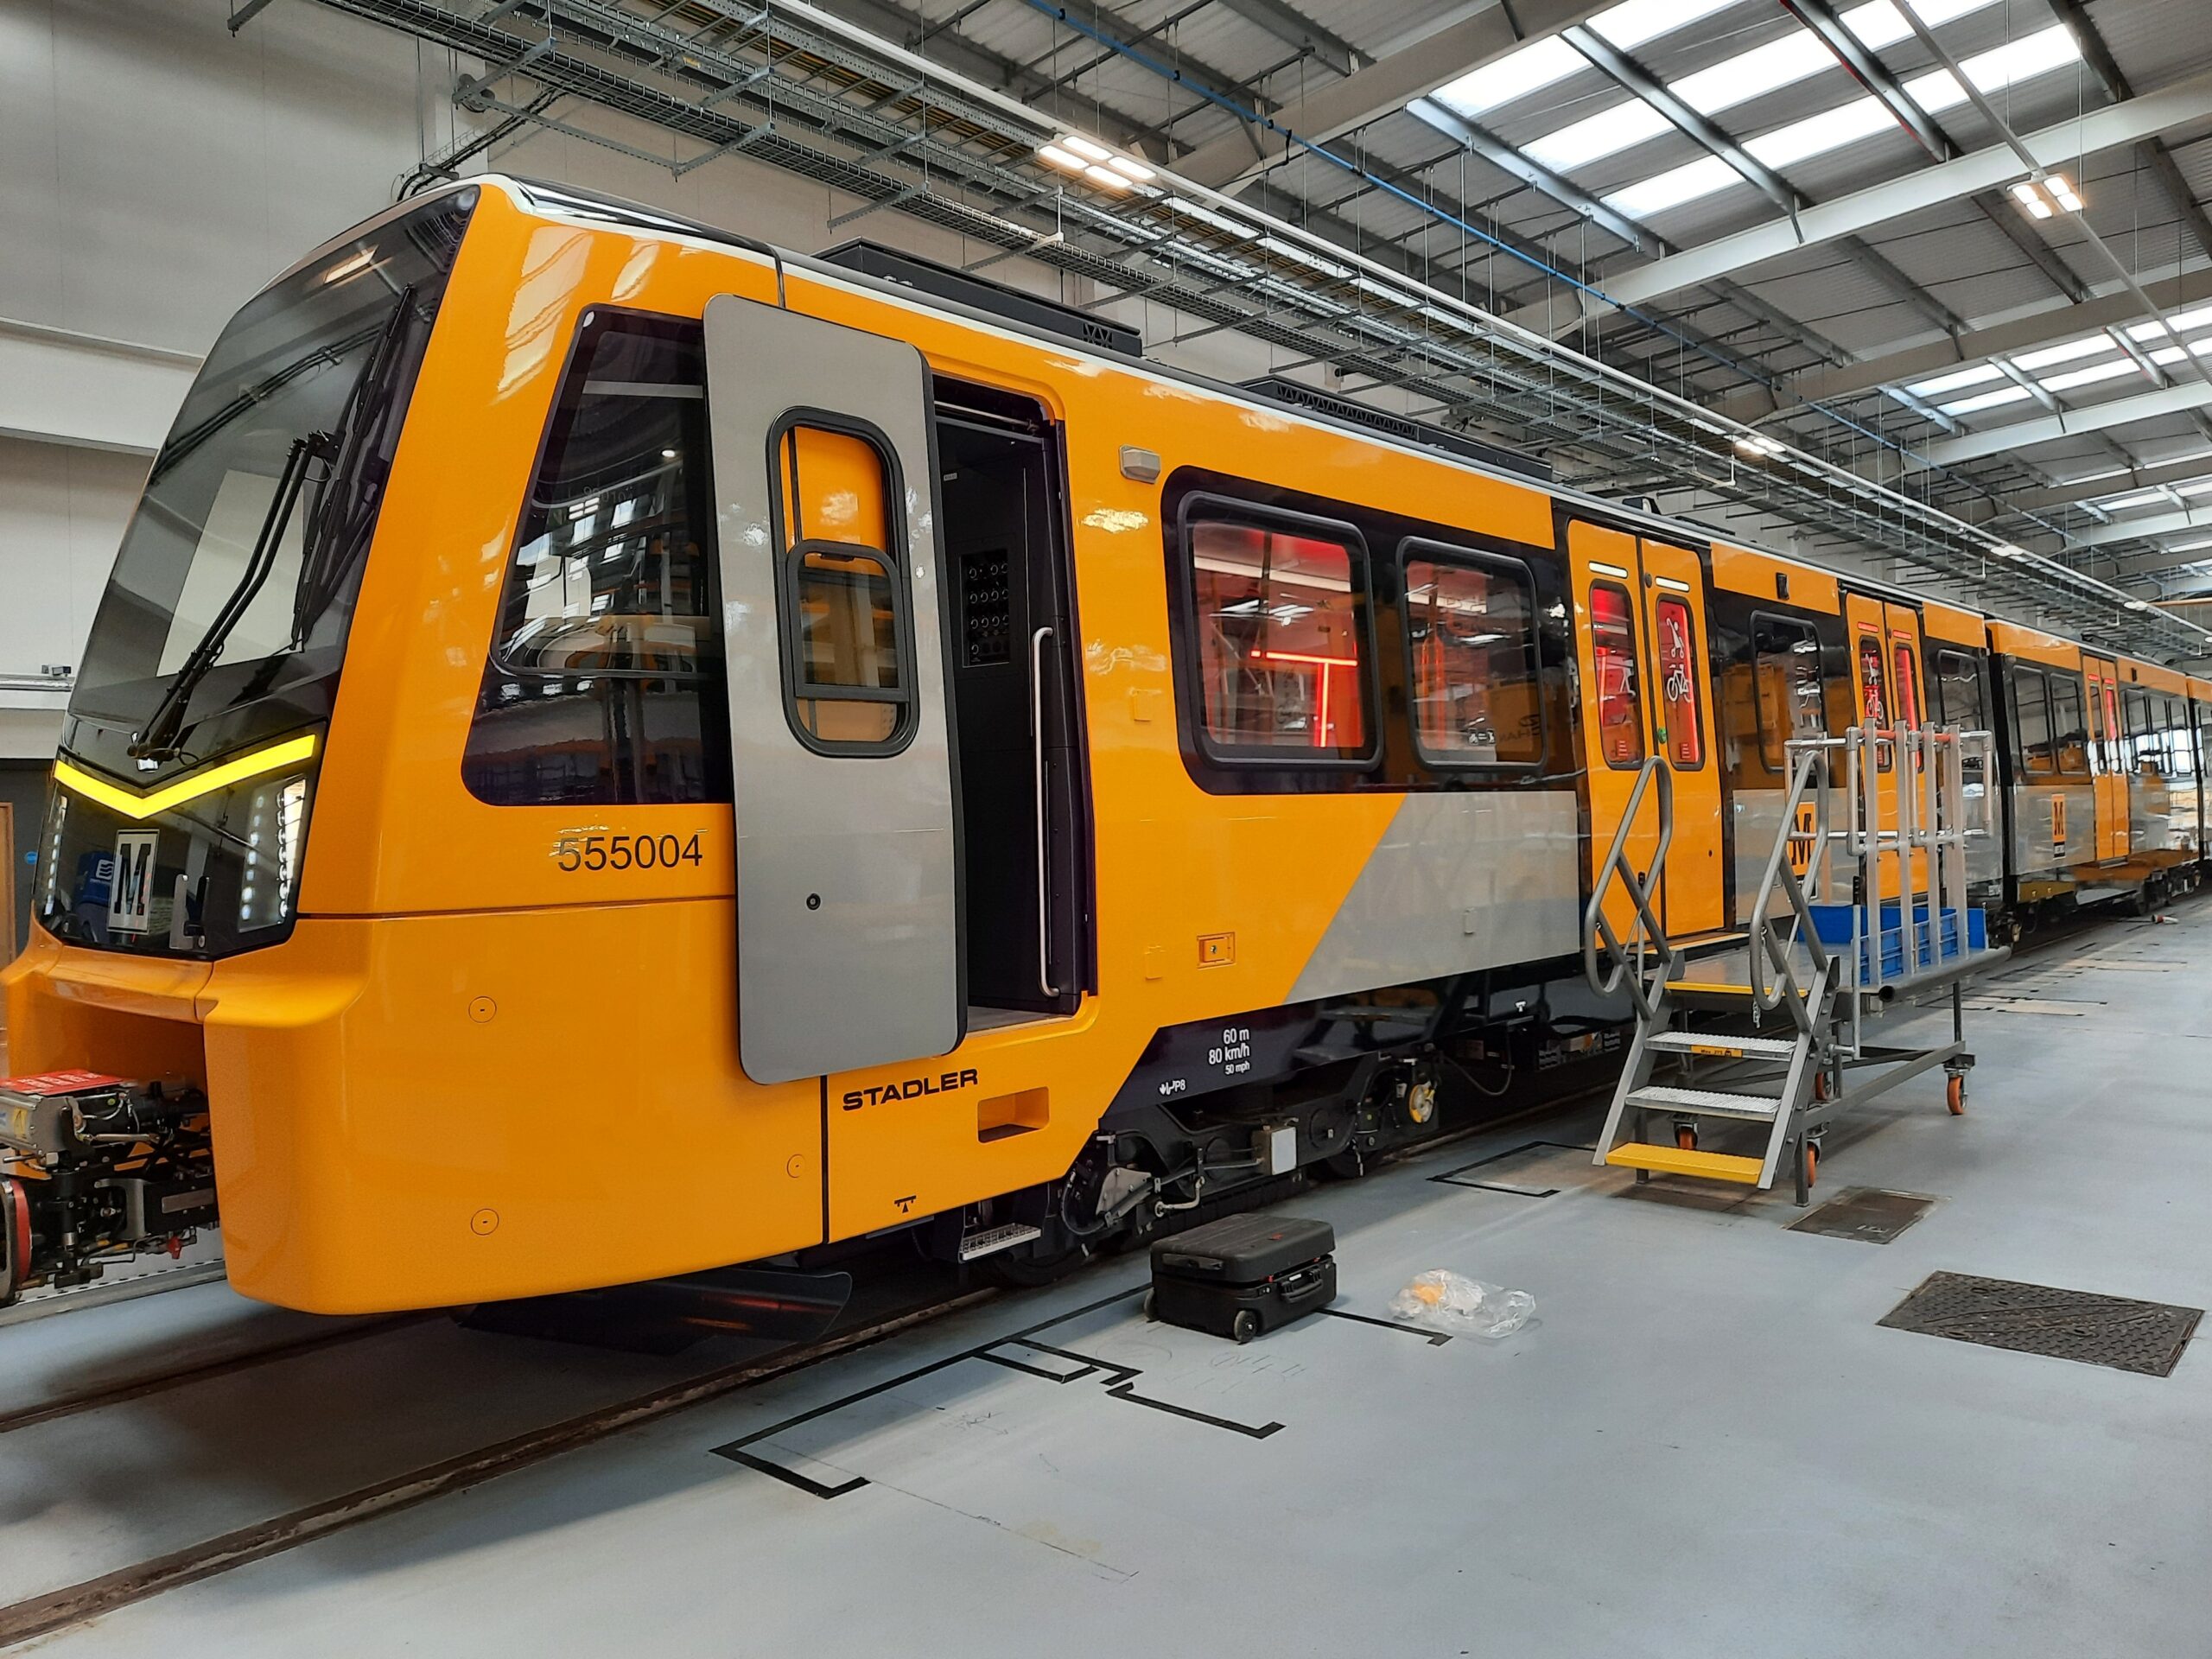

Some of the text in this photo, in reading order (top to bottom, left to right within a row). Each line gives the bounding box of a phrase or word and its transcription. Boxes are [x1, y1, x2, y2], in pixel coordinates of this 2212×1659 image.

[2054, 802, 2064, 836] M
[557, 835, 702, 872] 555004
[1791, 813, 1811, 865] M
[114, 843, 151, 916] M
[1208, 1043, 1249, 1065] 80 km/h
[1223, 1028, 1249, 1045] 60 m
[1225, 1061, 1250, 1075] 50 mph
[842, 1069, 978, 1111] STADLER
